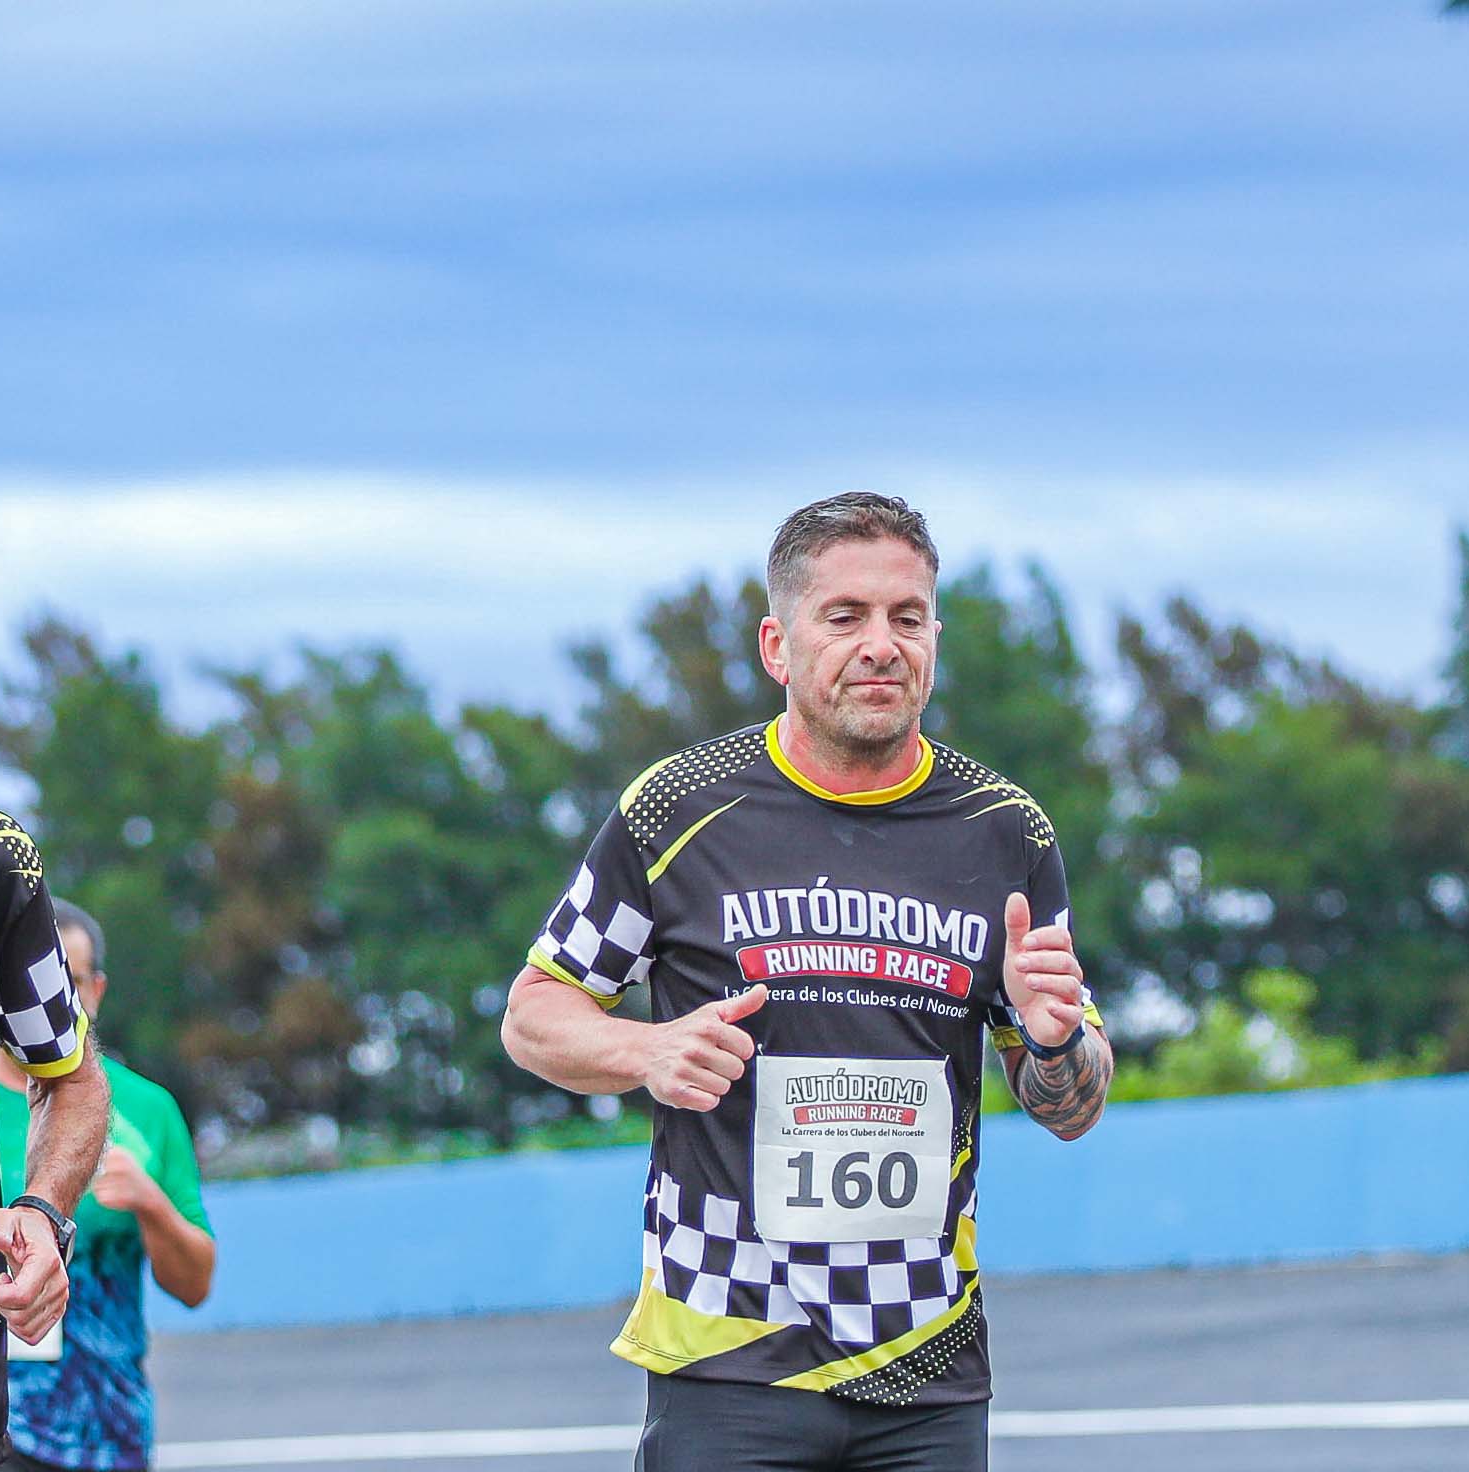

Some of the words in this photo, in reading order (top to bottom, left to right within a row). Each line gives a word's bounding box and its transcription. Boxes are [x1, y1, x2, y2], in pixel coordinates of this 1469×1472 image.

[721, 876, 989, 962] AUTÓDROMO
[764, 946, 877, 976] RUNNING
[885, 951, 951, 990] RACE
[799, 985, 819, 1001] de
[822, 986, 843, 1003] los
[846, 989, 897, 1007] Clubes
[899, 994, 924, 1010] del
[786, 1068, 927, 1106] AUTÓDROMO
[781, 1127, 791, 1135] La
[792, 1127, 823, 1136] Carrera
[824, 1128, 835, 1136] de
[836, 1128, 849, 1137] los
[850, 1128, 876, 1137] Clubes
[877, 1128, 891, 1137] del
[892, 1128, 925, 1137] Noroeste
[807, 1105, 866, 1122] RUNNING
[870, 1106, 903, 1123] RACE
[786, 1151, 918, 1209] 160
